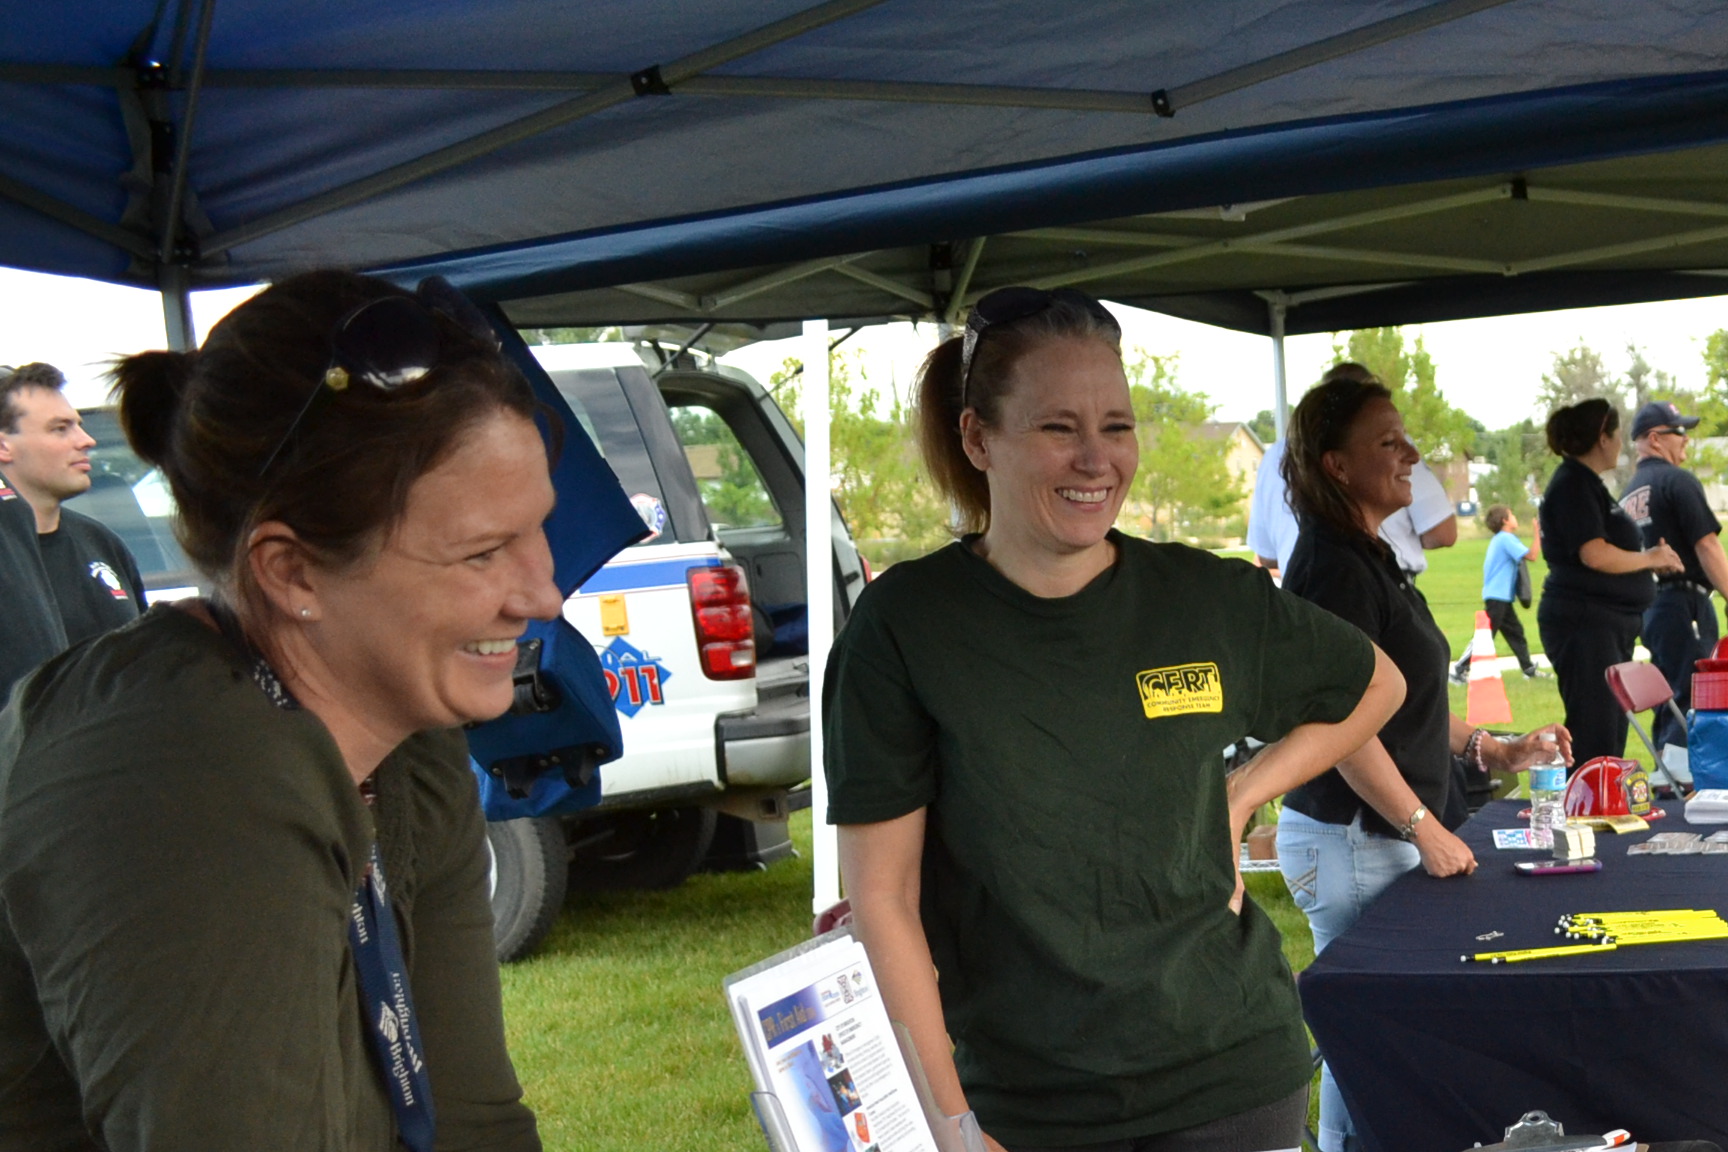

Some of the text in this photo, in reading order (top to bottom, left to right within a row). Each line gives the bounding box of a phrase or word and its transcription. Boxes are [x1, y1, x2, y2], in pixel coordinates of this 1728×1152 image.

[606, 650, 662, 665] IAL
[1141, 666, 1218, 699] CERT
[1148, 698, 1186, 708] COMMUNITY
[1163, 704, 1194, 712] RESPONSE
[388, 1041, 415, 1107] Brighton
